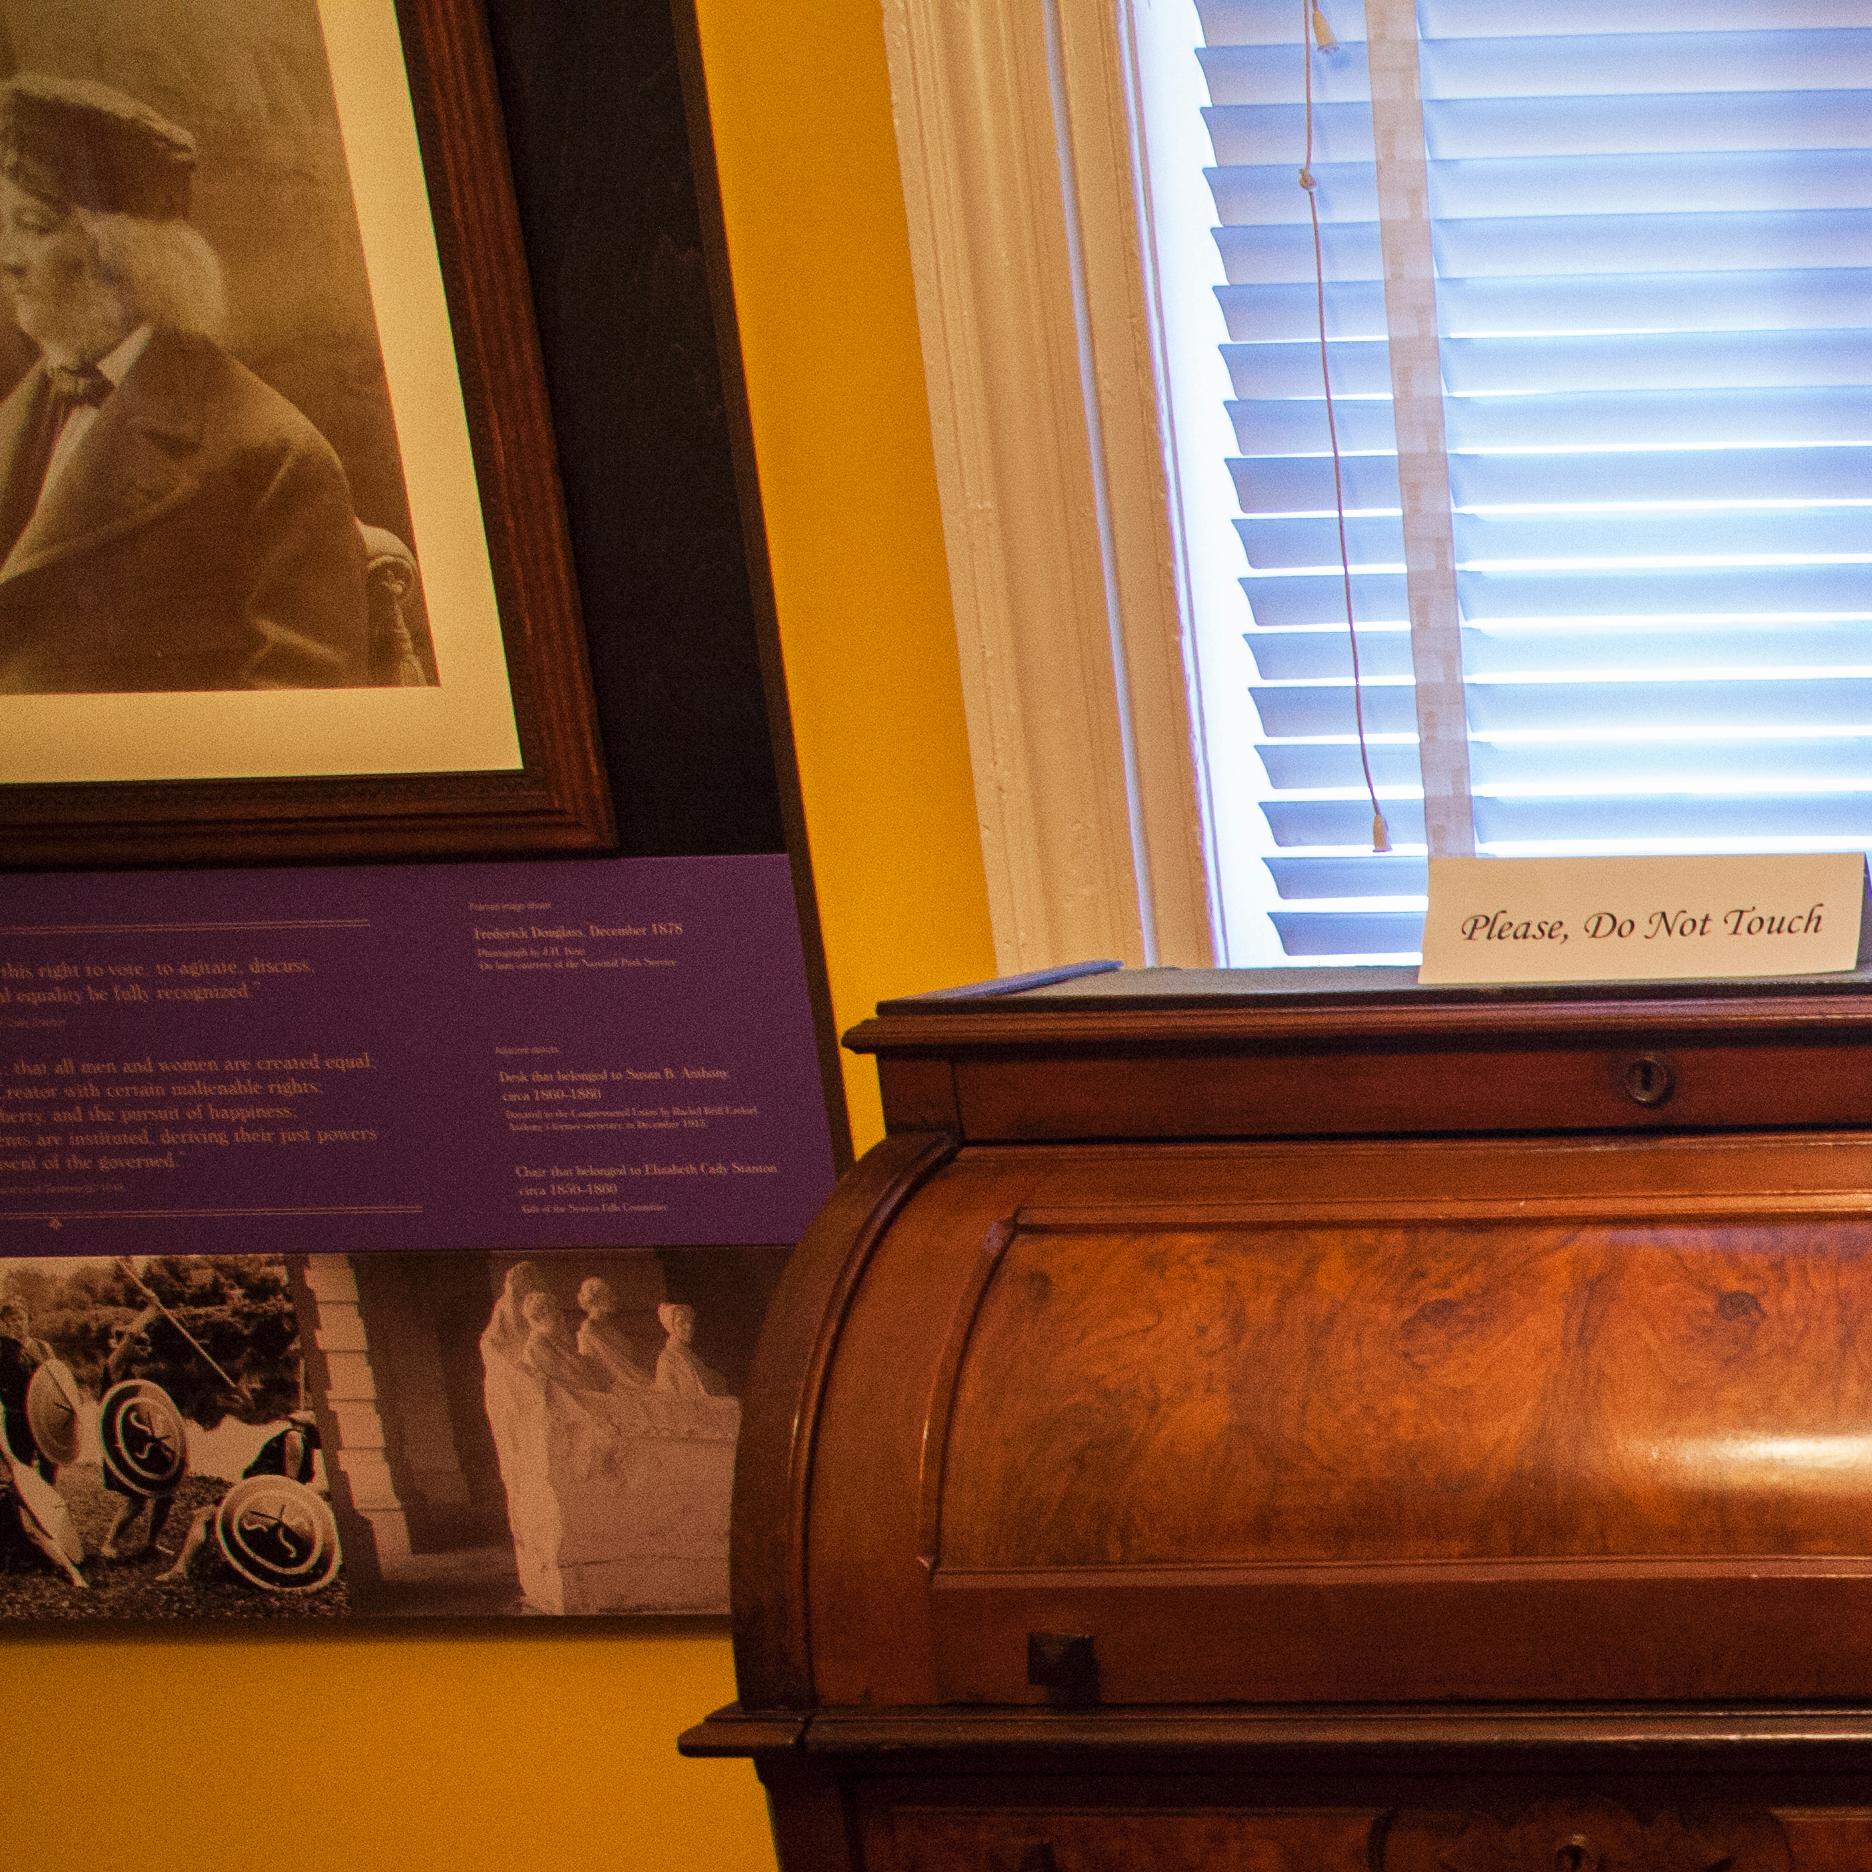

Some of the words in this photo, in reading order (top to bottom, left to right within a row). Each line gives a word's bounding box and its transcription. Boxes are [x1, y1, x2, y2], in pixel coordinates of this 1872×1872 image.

[1460, 909, 1570, 945] Please,
[1584, 911, 1636, 940] Do
[1644, 909, 1713, 940] Not
[1723, 902, 1825, 937] Touch
